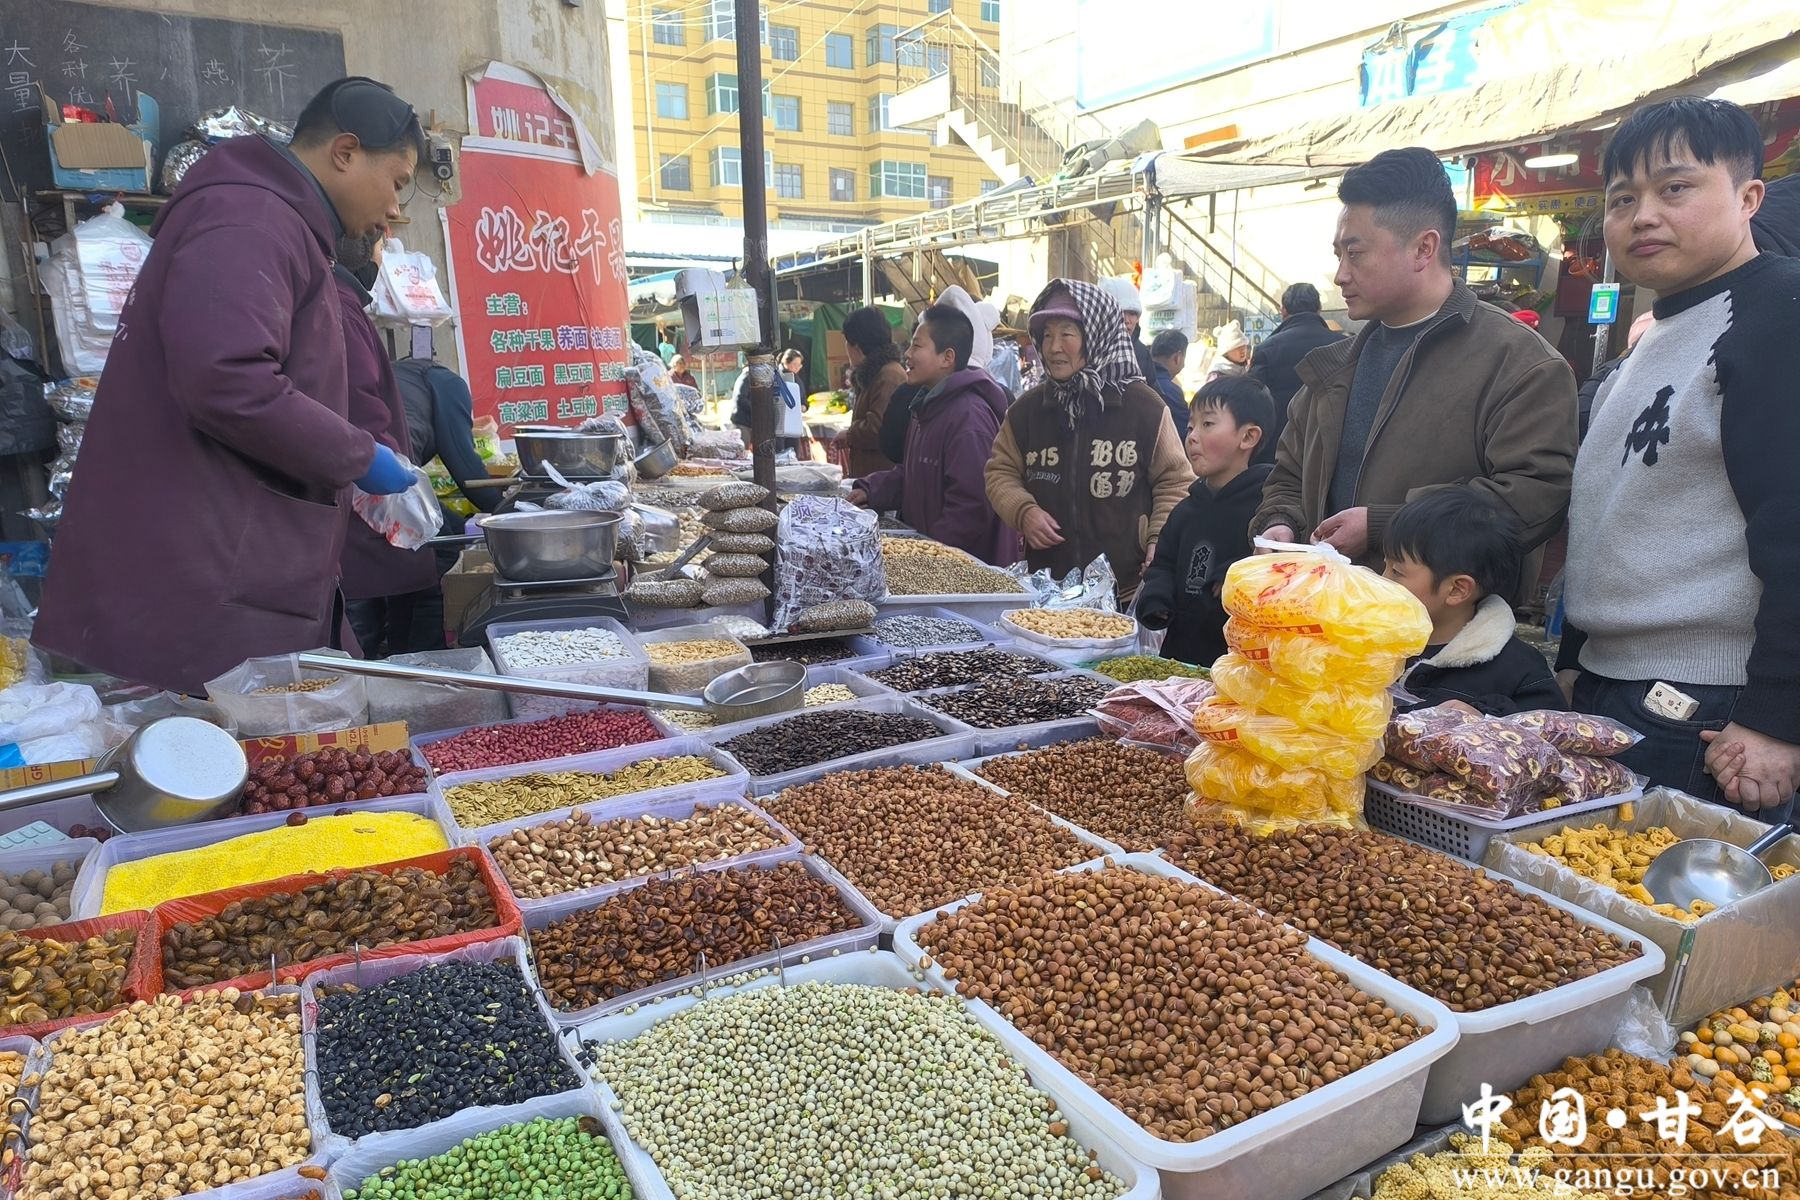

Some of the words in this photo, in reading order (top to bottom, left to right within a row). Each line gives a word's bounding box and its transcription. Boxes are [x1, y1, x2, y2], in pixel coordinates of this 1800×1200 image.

[5, 40, 41, 113] 大量
[491, 328, 556, 353] 各种干果
[557, 325, 588, 351] 荞面
[495, 364, 545, 388] 扁豆面
[553, 362, 594, 385] 黑豆面
[557, 395, 597, 418] 土豆粉
